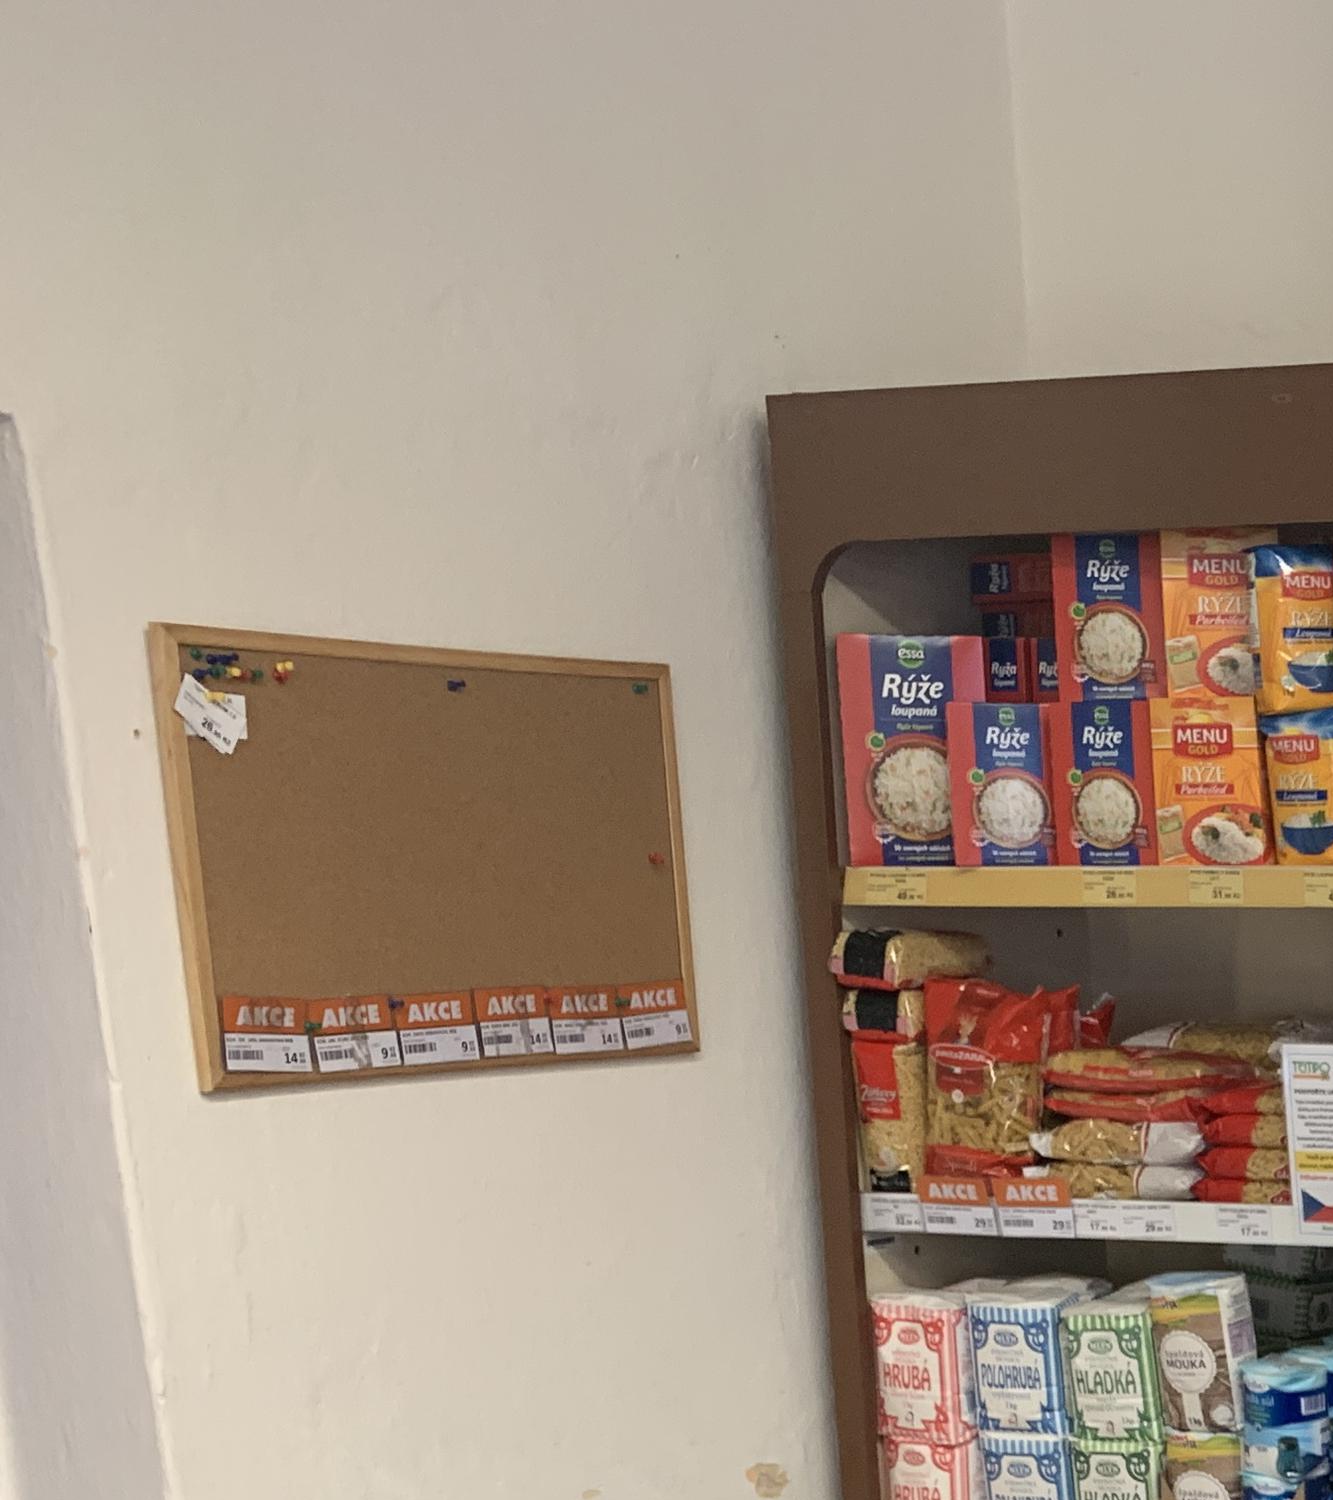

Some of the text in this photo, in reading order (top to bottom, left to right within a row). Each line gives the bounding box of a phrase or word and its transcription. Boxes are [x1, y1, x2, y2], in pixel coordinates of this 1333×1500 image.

[1192, 556, 1246, 575] MENU
[882, 675, 944, 706] Rýže
[1176, 730, 1228, 749] MENU
[408, 1000, 462, 1022] AKCE
[884, 1359, 931, 1392] HRUBÁ
[981, 1362, 1041, 1391] POLOHRUBÁ
[1077, 1367, 1137, 1401] HLADKÁ
